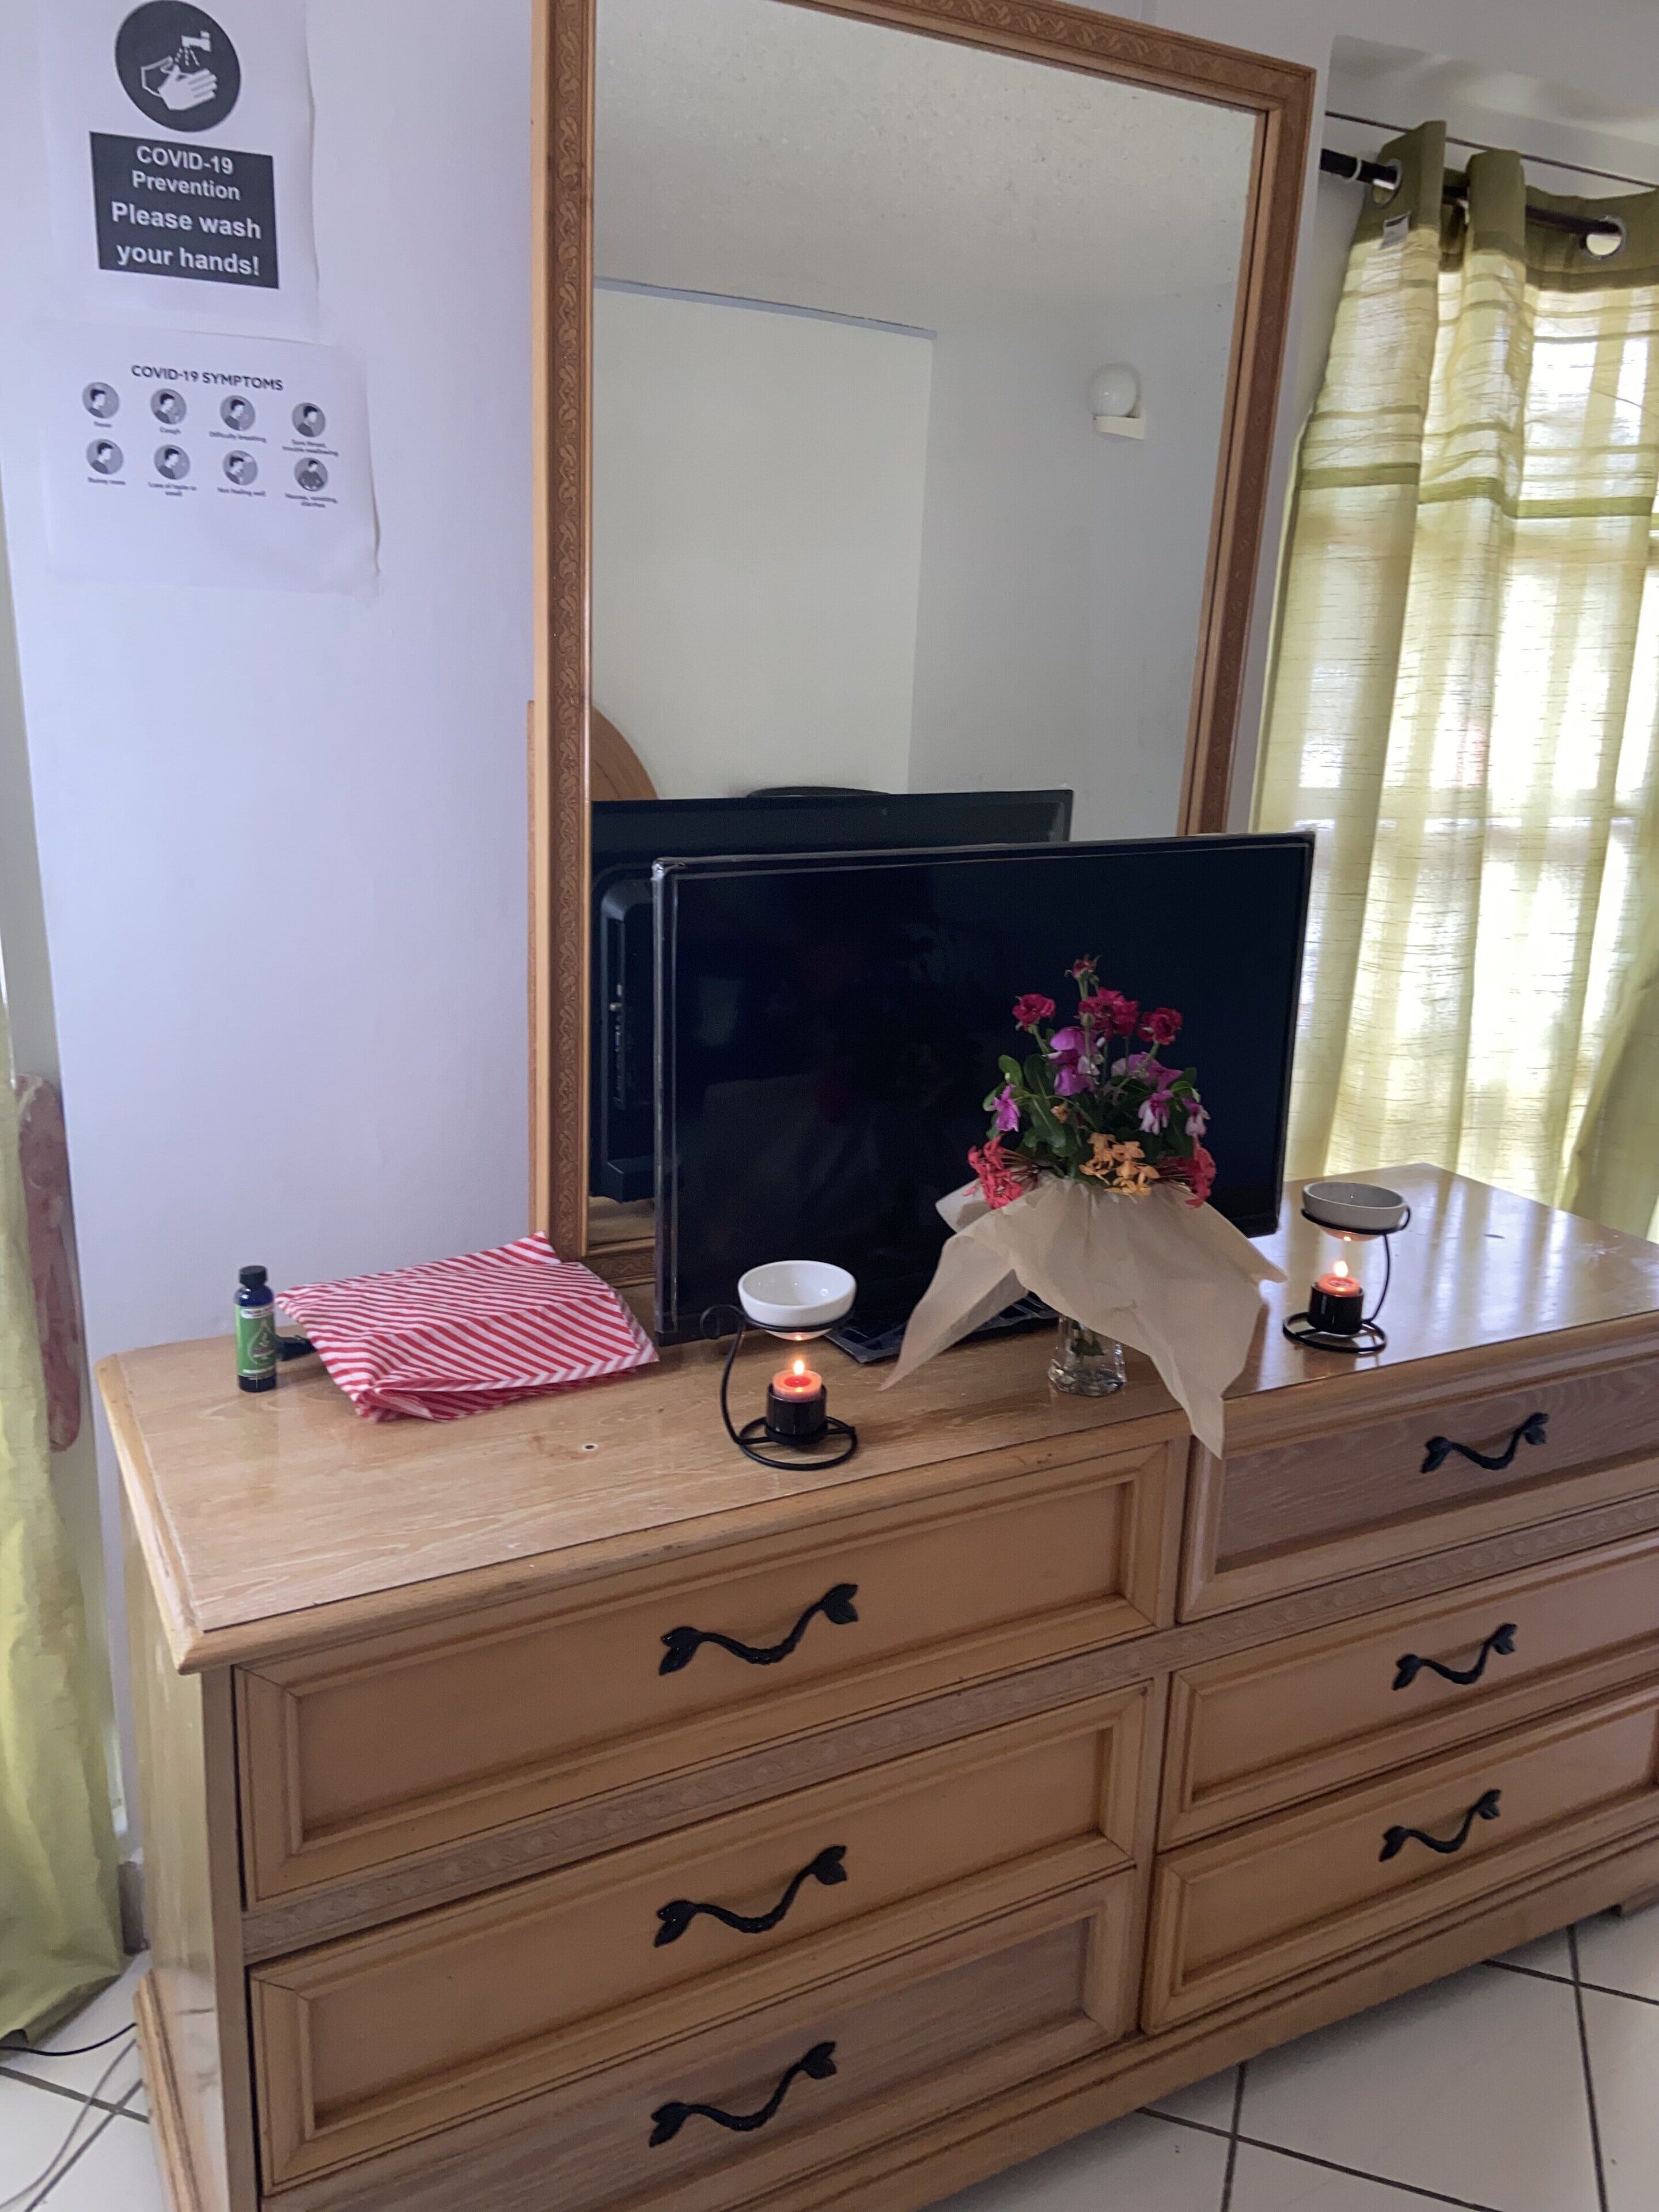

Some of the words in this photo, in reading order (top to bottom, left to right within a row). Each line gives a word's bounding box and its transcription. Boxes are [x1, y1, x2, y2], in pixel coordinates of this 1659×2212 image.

[136, 145, 234, 175] COVID-19
[132, 169, 241, 201] Prevention
[111, 200, 193, 231] Please
[199, 217, 262, 240] wash
[116, 244, 173, 266] your
[179, 246, 260, 276] hands!
[131, 365, 199, 382] COVID-19
[202, 372, 284, 391] SYMPTOMS
